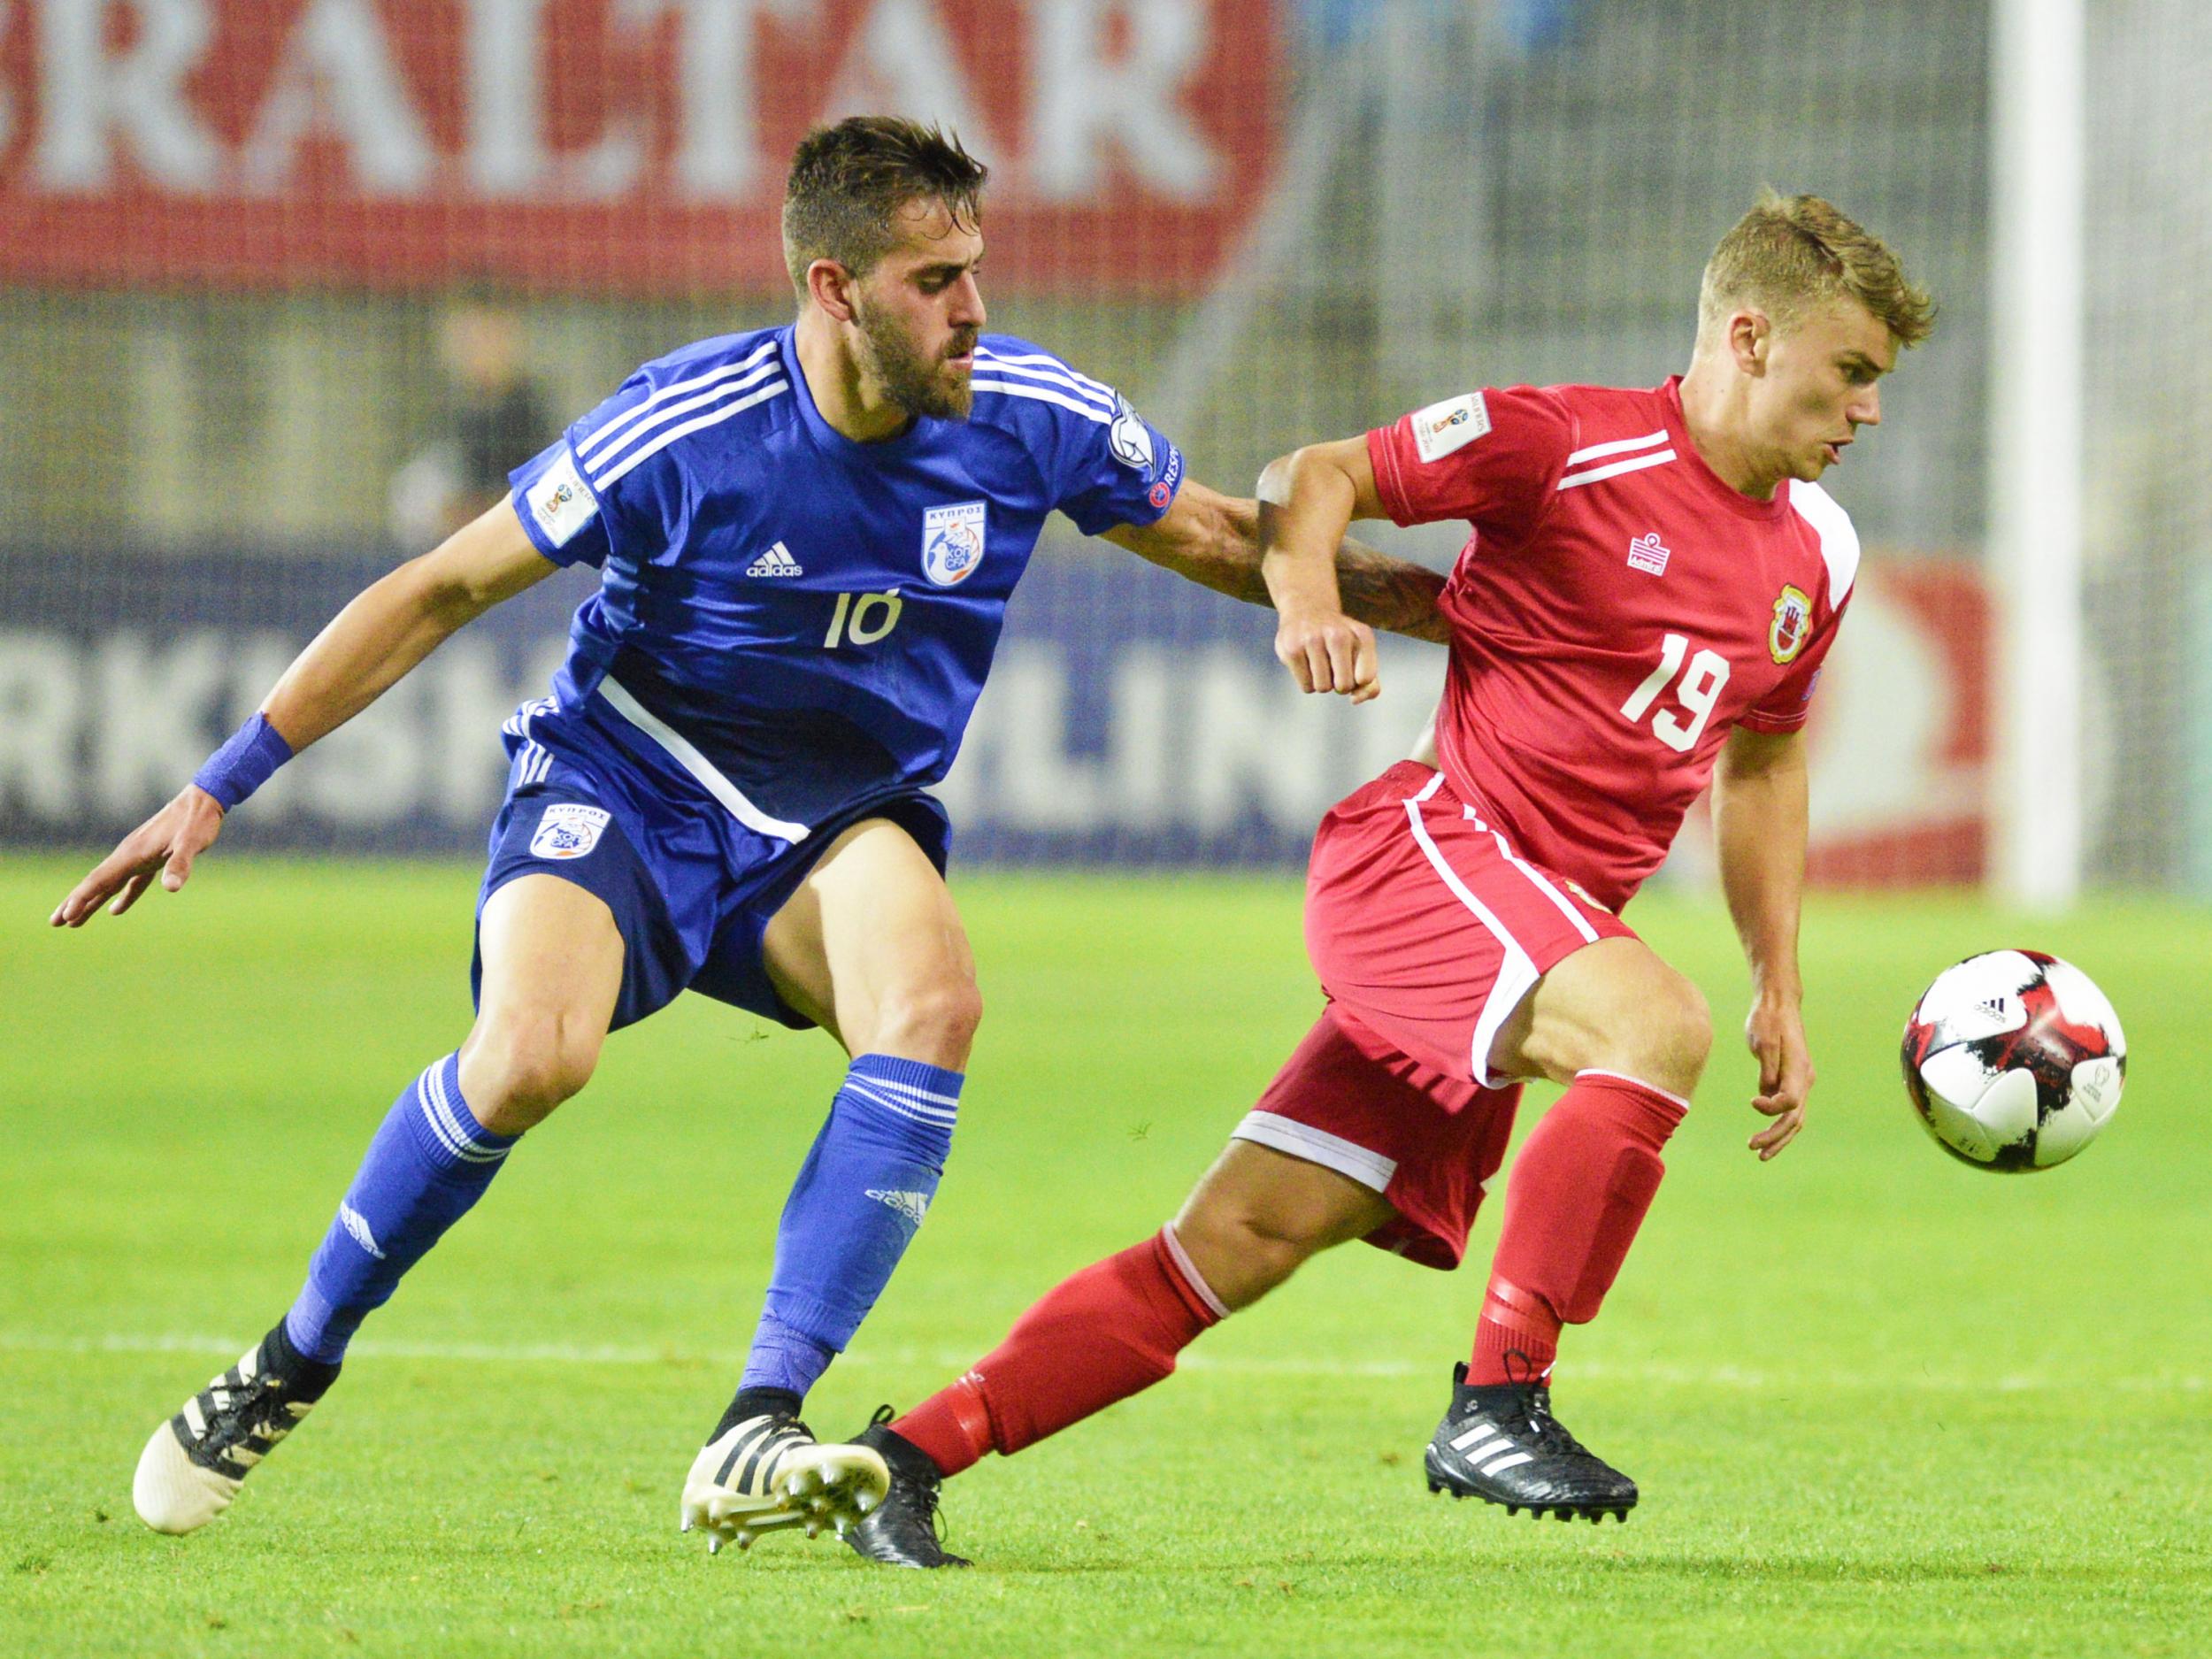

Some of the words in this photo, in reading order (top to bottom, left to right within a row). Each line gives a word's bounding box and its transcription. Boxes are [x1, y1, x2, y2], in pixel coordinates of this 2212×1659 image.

[0, 0, 1228, 199] RALTAR
[929, 506, 982, 520] ΚΥΠΡΟΣ
[746, 565, 803, 578] adidas
[824, 588, 902, 648] 10
[1619, 634, 1730, 752] 19
